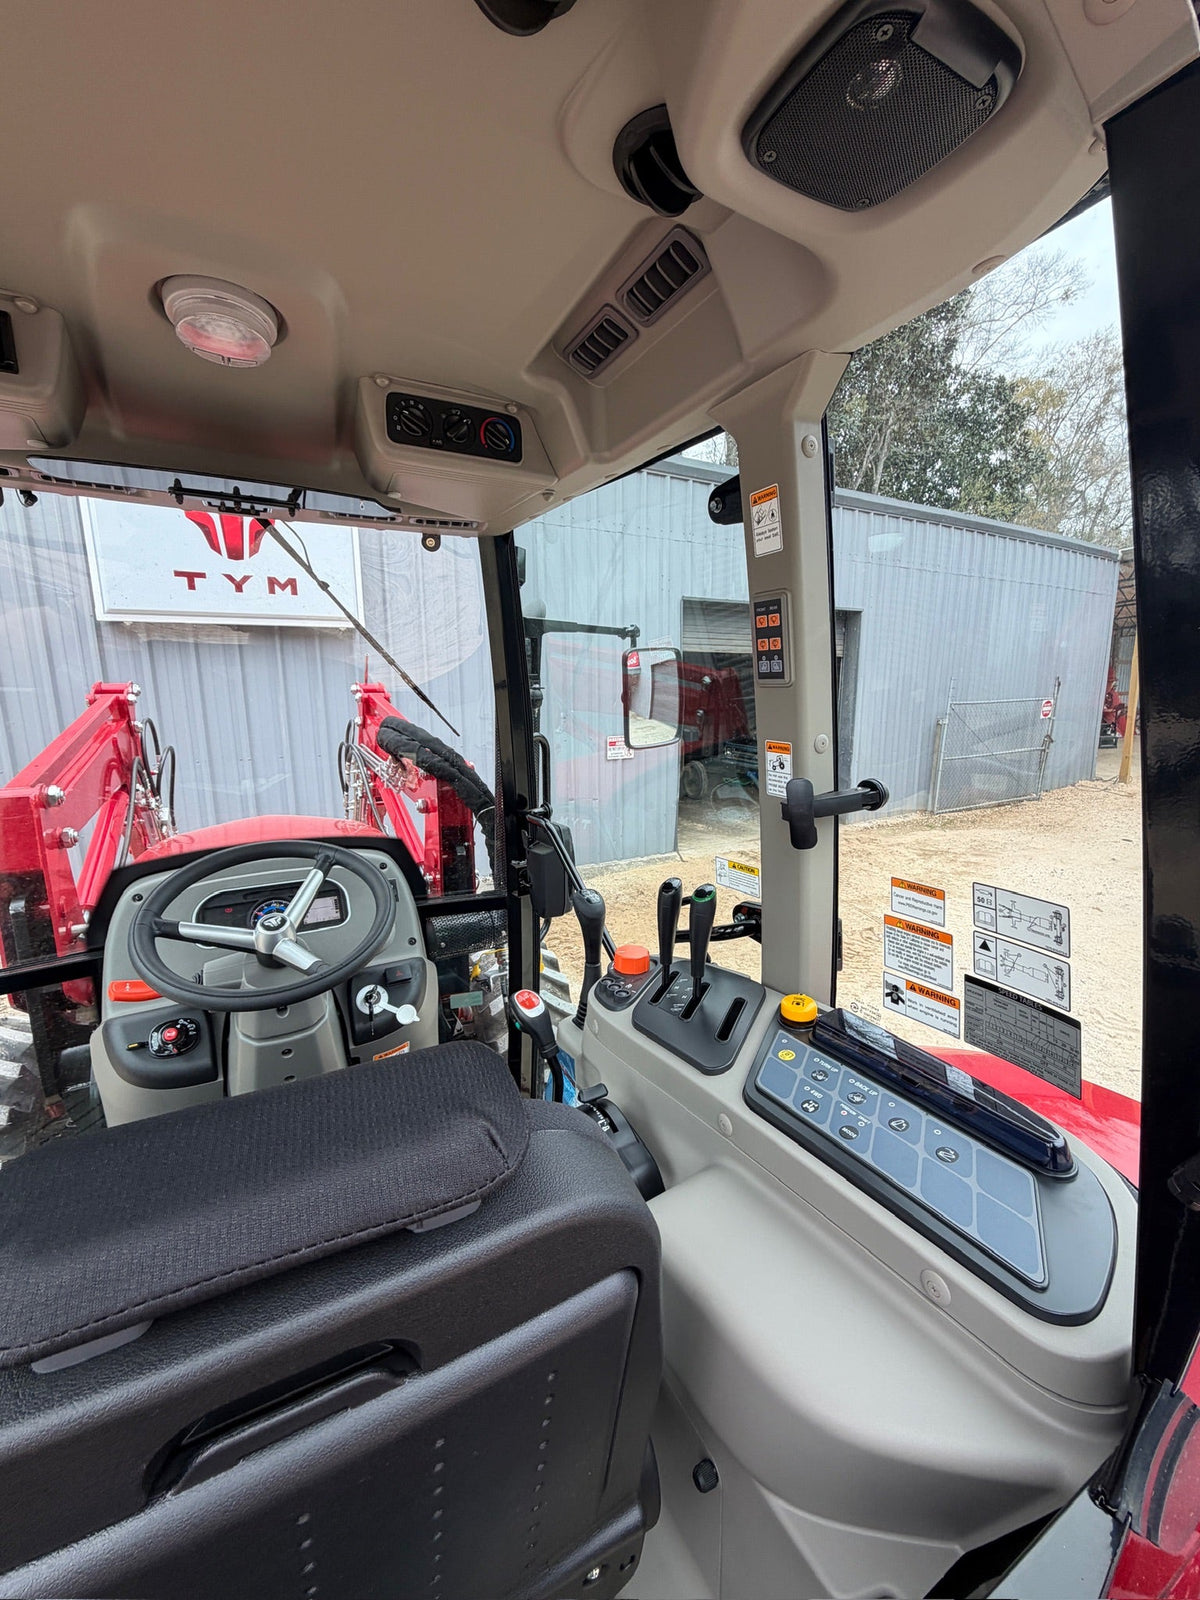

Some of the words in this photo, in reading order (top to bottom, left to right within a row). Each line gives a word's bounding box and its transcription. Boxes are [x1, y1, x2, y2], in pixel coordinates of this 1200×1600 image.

[174, 570, 298, 595] TYM
[907, 883, 937, 897] WARNING
[905, 923, 939, 940] WARNING
[918, 986, 956, 1007] WARNING
[998, 987, 1018, 1000] SPEED
[1020, 996, 1043, 1011] TABLES
[819, 1059, 832, 1069] TURN
[854, 1081, 869, 1091] BACK
[811, 1089, 824, 1098] 4WD
[841, 1127, 857, 1138] MODE
